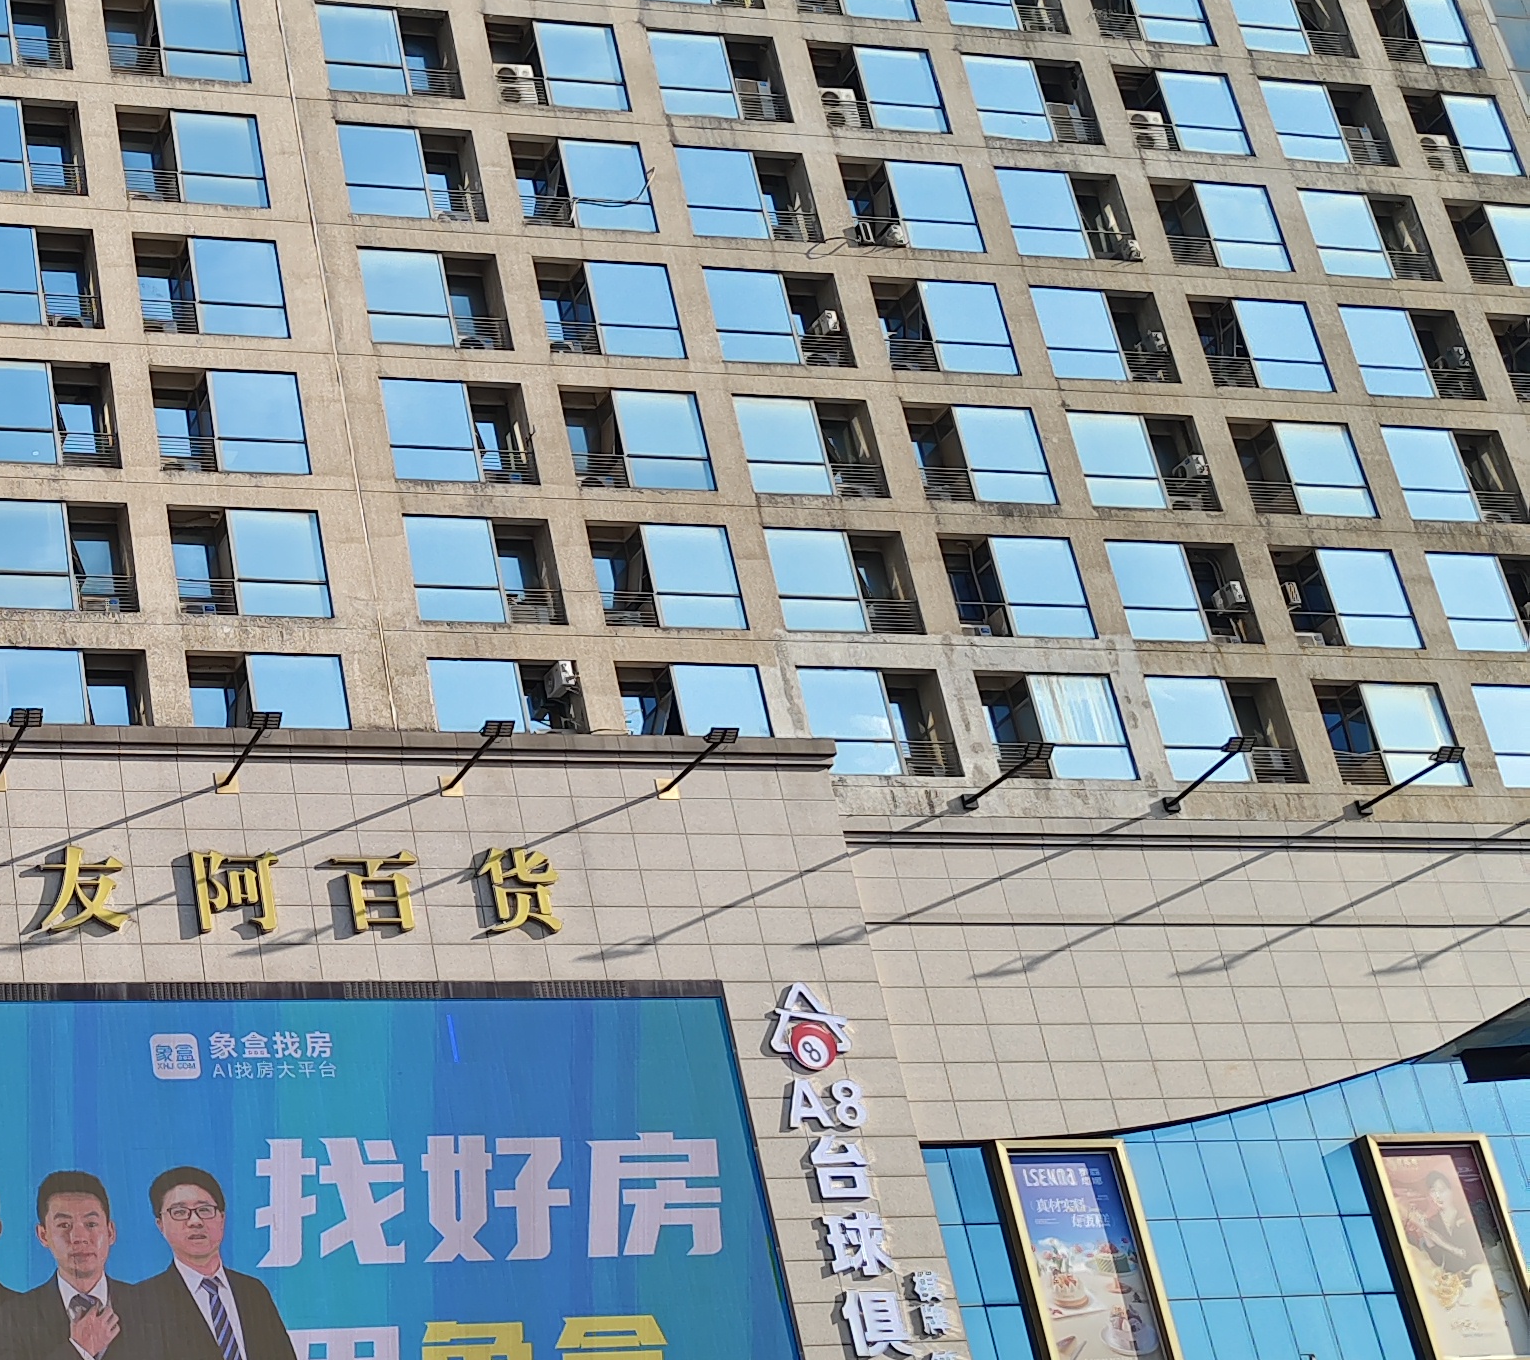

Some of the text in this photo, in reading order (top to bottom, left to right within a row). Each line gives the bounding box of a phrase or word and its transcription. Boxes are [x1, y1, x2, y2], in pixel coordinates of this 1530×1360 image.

[40, 845, 563, 935] 友阿百货
[208, 1031, 333, 1059] 象盒找房
[212, 1060, 337, 1079] AI找房大平台
[255, 1132, 723, 1268] 找好房
